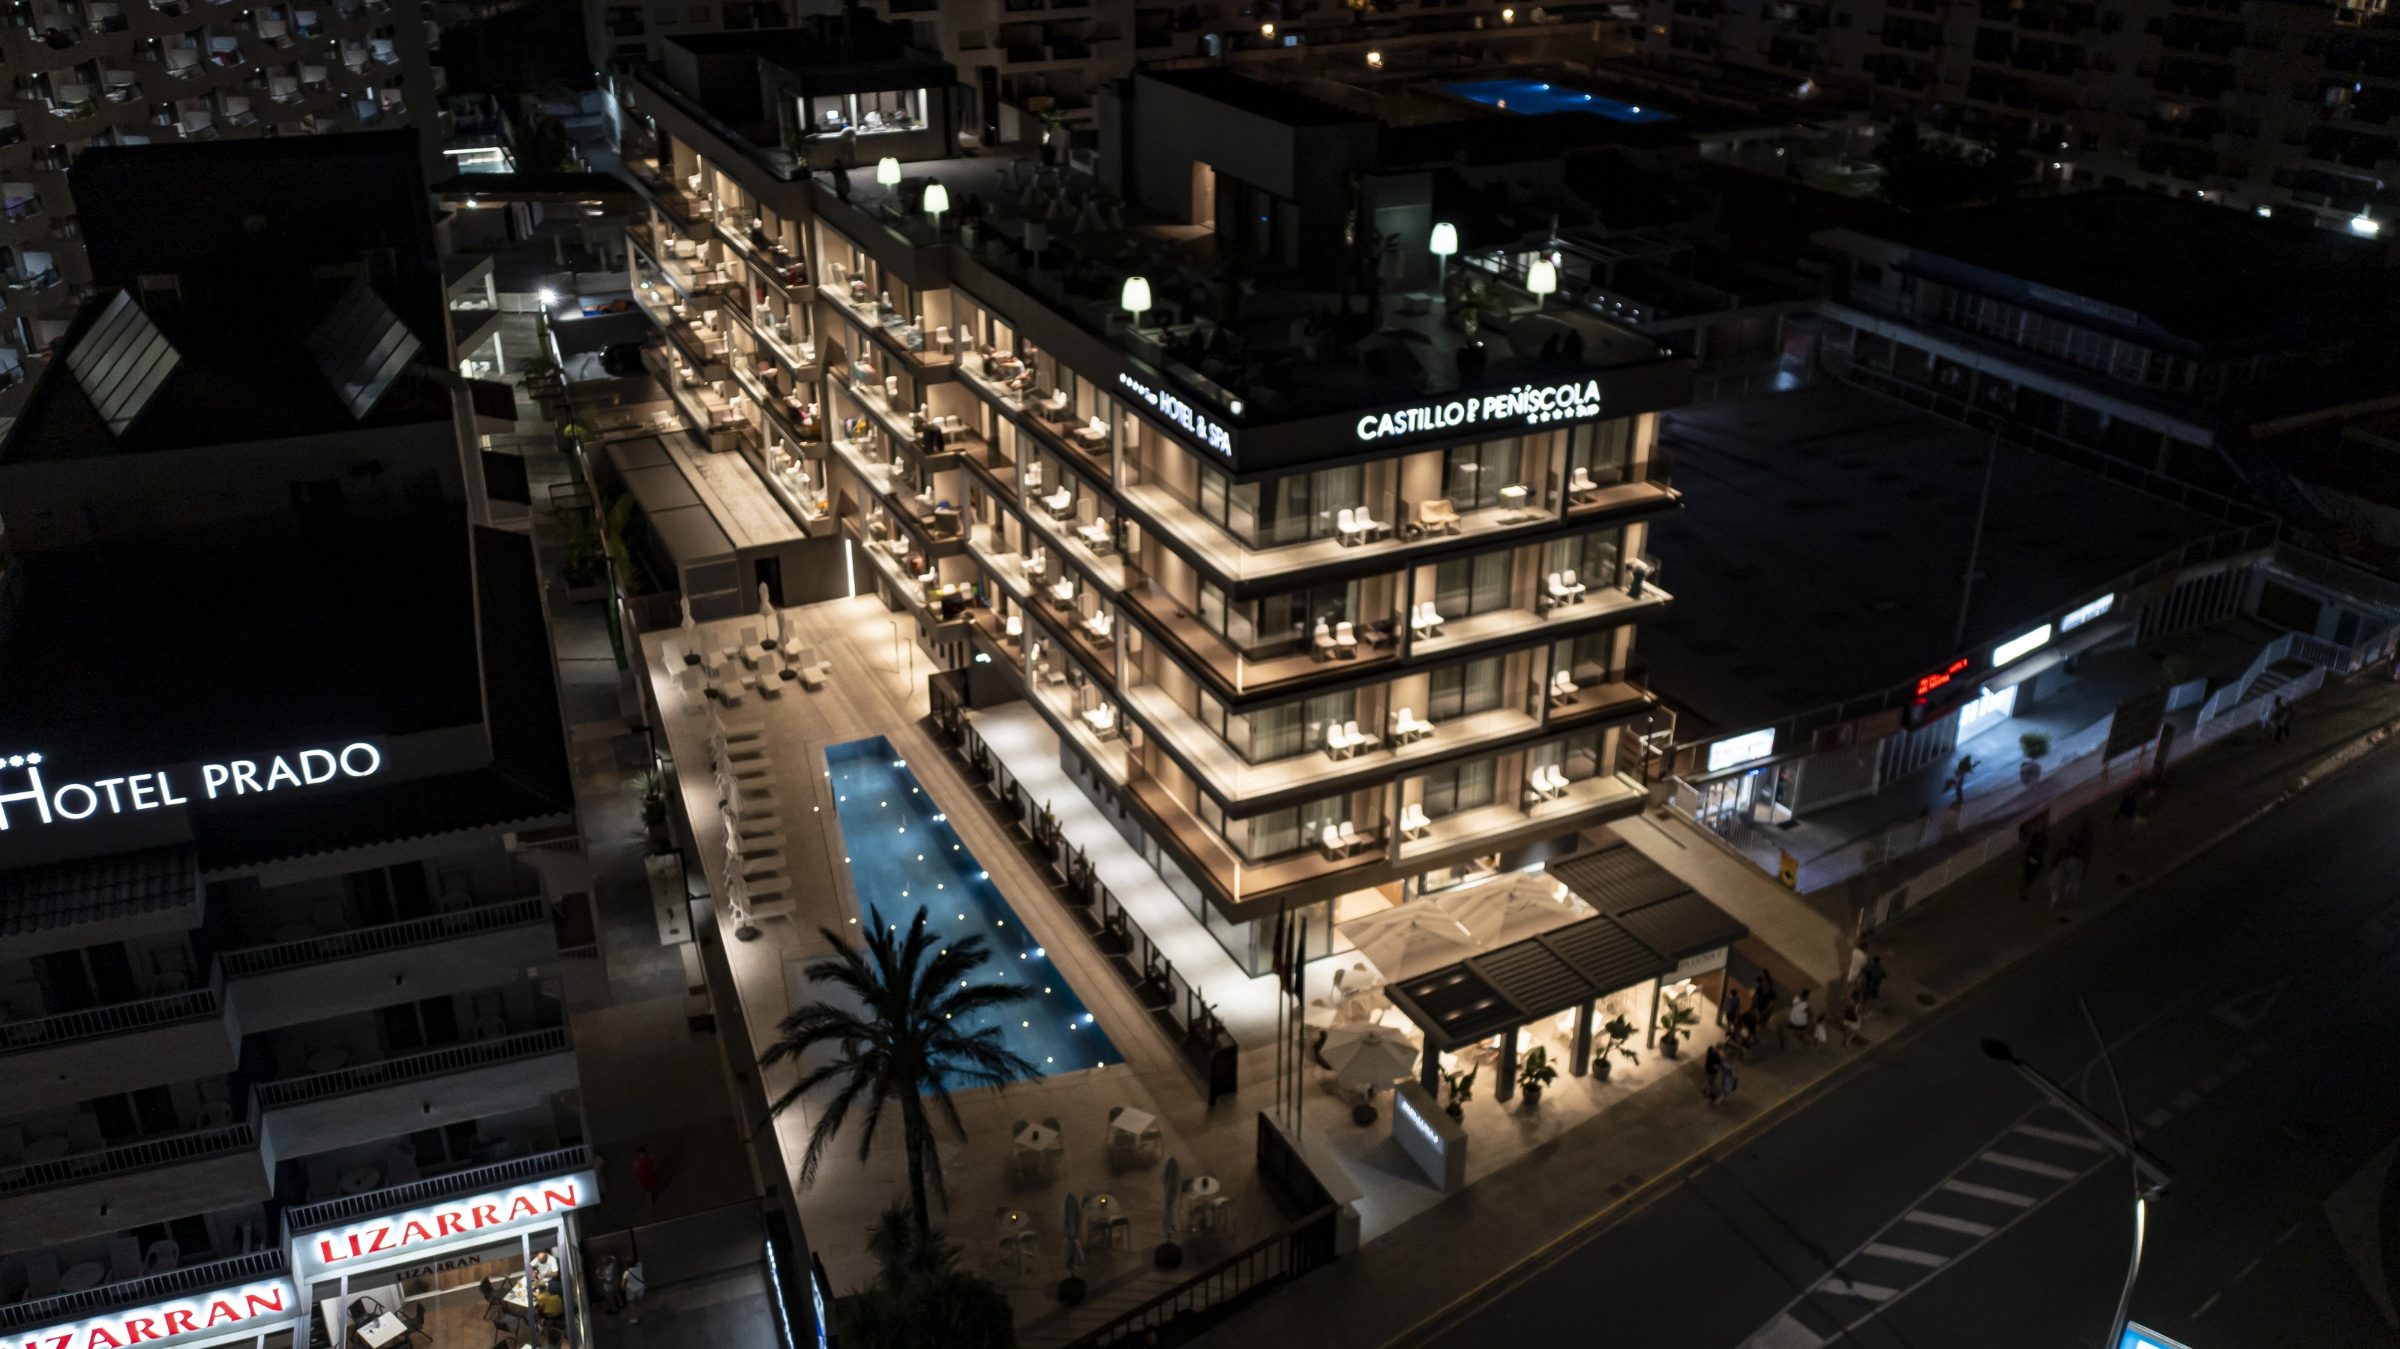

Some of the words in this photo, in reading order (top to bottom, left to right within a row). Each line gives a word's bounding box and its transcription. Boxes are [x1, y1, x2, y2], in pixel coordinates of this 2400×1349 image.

[1159, 390, 1195, 432] HOTEL
[1196, 415, 1208, 440] &
[1208, 423, 1232, 457] SPA
[1357, 401, 1465, 440] CASTILLO
[1482, 380, 1600, 420] PEÑÍSCOLA
[0, 766, 187, 830] HOTEL
[203, 742, 380, 799] PRADO
[320, 1184, 577, 1263] LIZARRAN
[397, 1255, 480, 1281] LIZARRAN
[0, 1287, 283, 1349] ZARRAN
